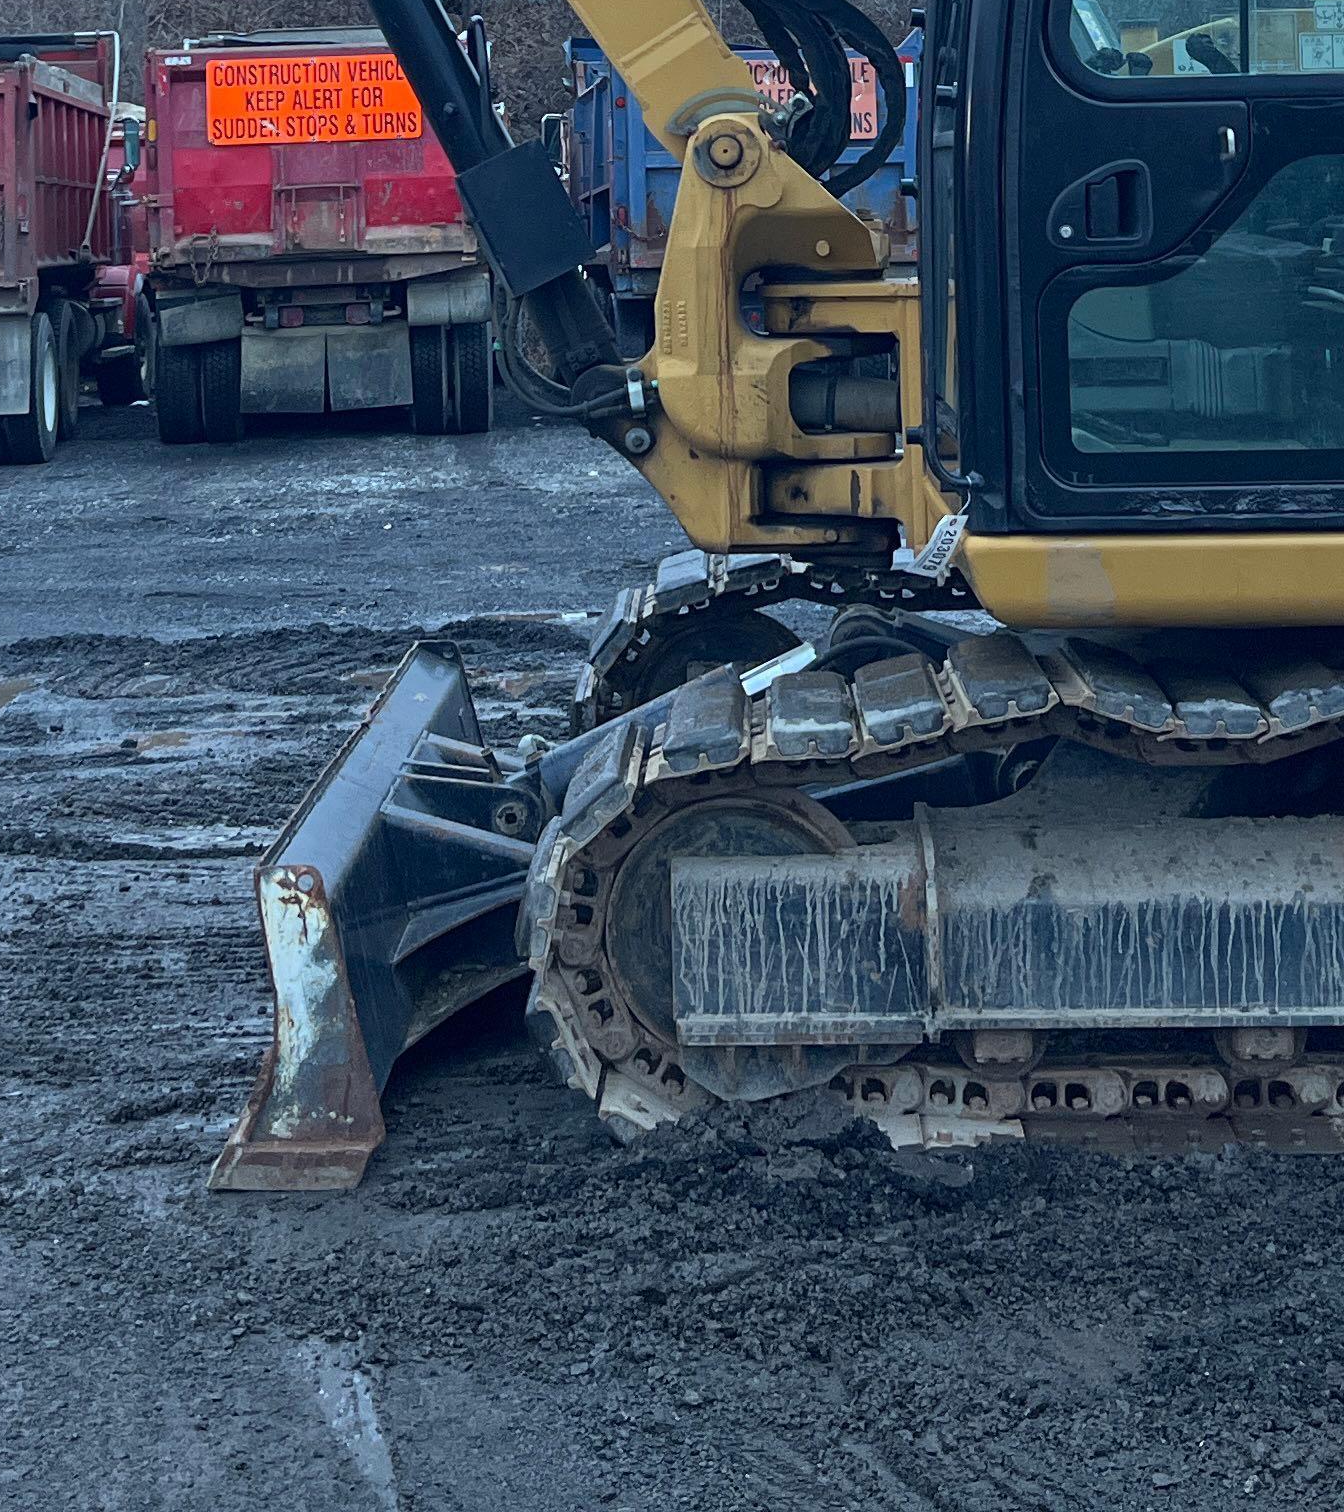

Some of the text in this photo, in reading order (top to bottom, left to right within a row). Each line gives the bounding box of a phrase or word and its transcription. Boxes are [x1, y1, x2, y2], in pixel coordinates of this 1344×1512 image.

[213, 59, 405, 88] CONSTRUCTION VEHICL
[245, 86, 384, 112] KEEP ALERT FOR
[213, 111, 418, 140] SUDDEN STOPS & TURNS
[921, 529, 958, 572] 203079
